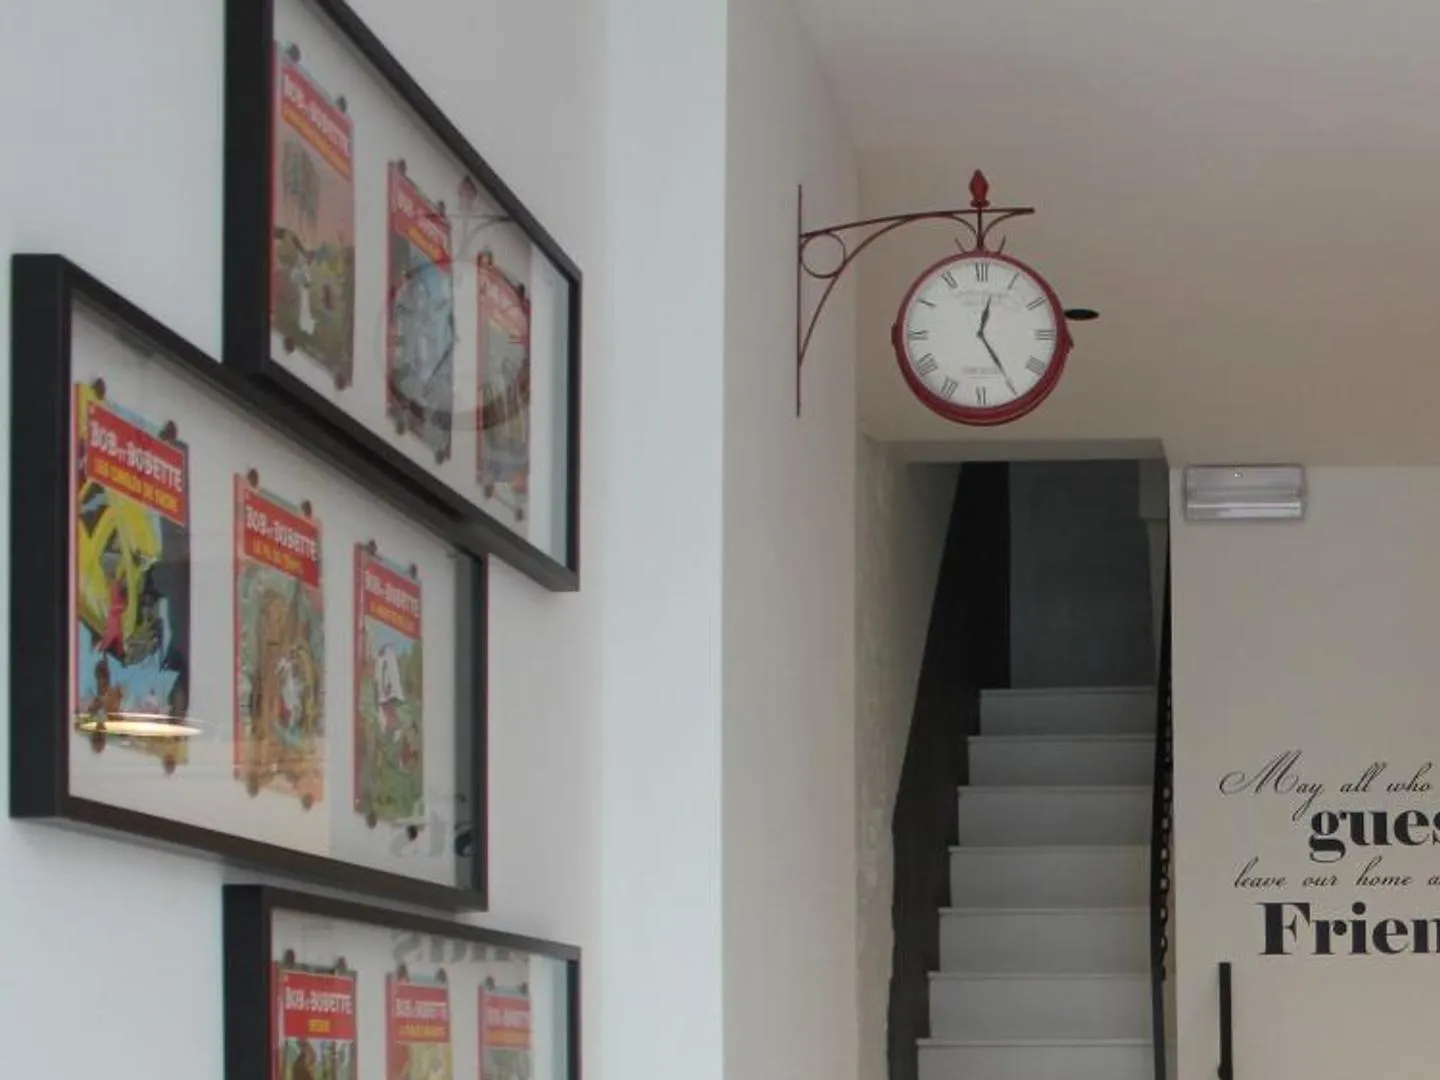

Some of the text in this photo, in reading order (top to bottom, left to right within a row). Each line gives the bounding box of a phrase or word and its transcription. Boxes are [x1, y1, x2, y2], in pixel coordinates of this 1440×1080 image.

[90, 420, 118, 457] BOB
[126, 440, 184, 494] BOBETTE
[1218, 748, 1325, 822] May
[1339, 761, 1387, 793] all
[1385, 761, 1433, 793] who
[1233, 856, 1287, 889] leave
[1302, 875, 1339, 887] our
[1355, 855, 1413, 887] home
